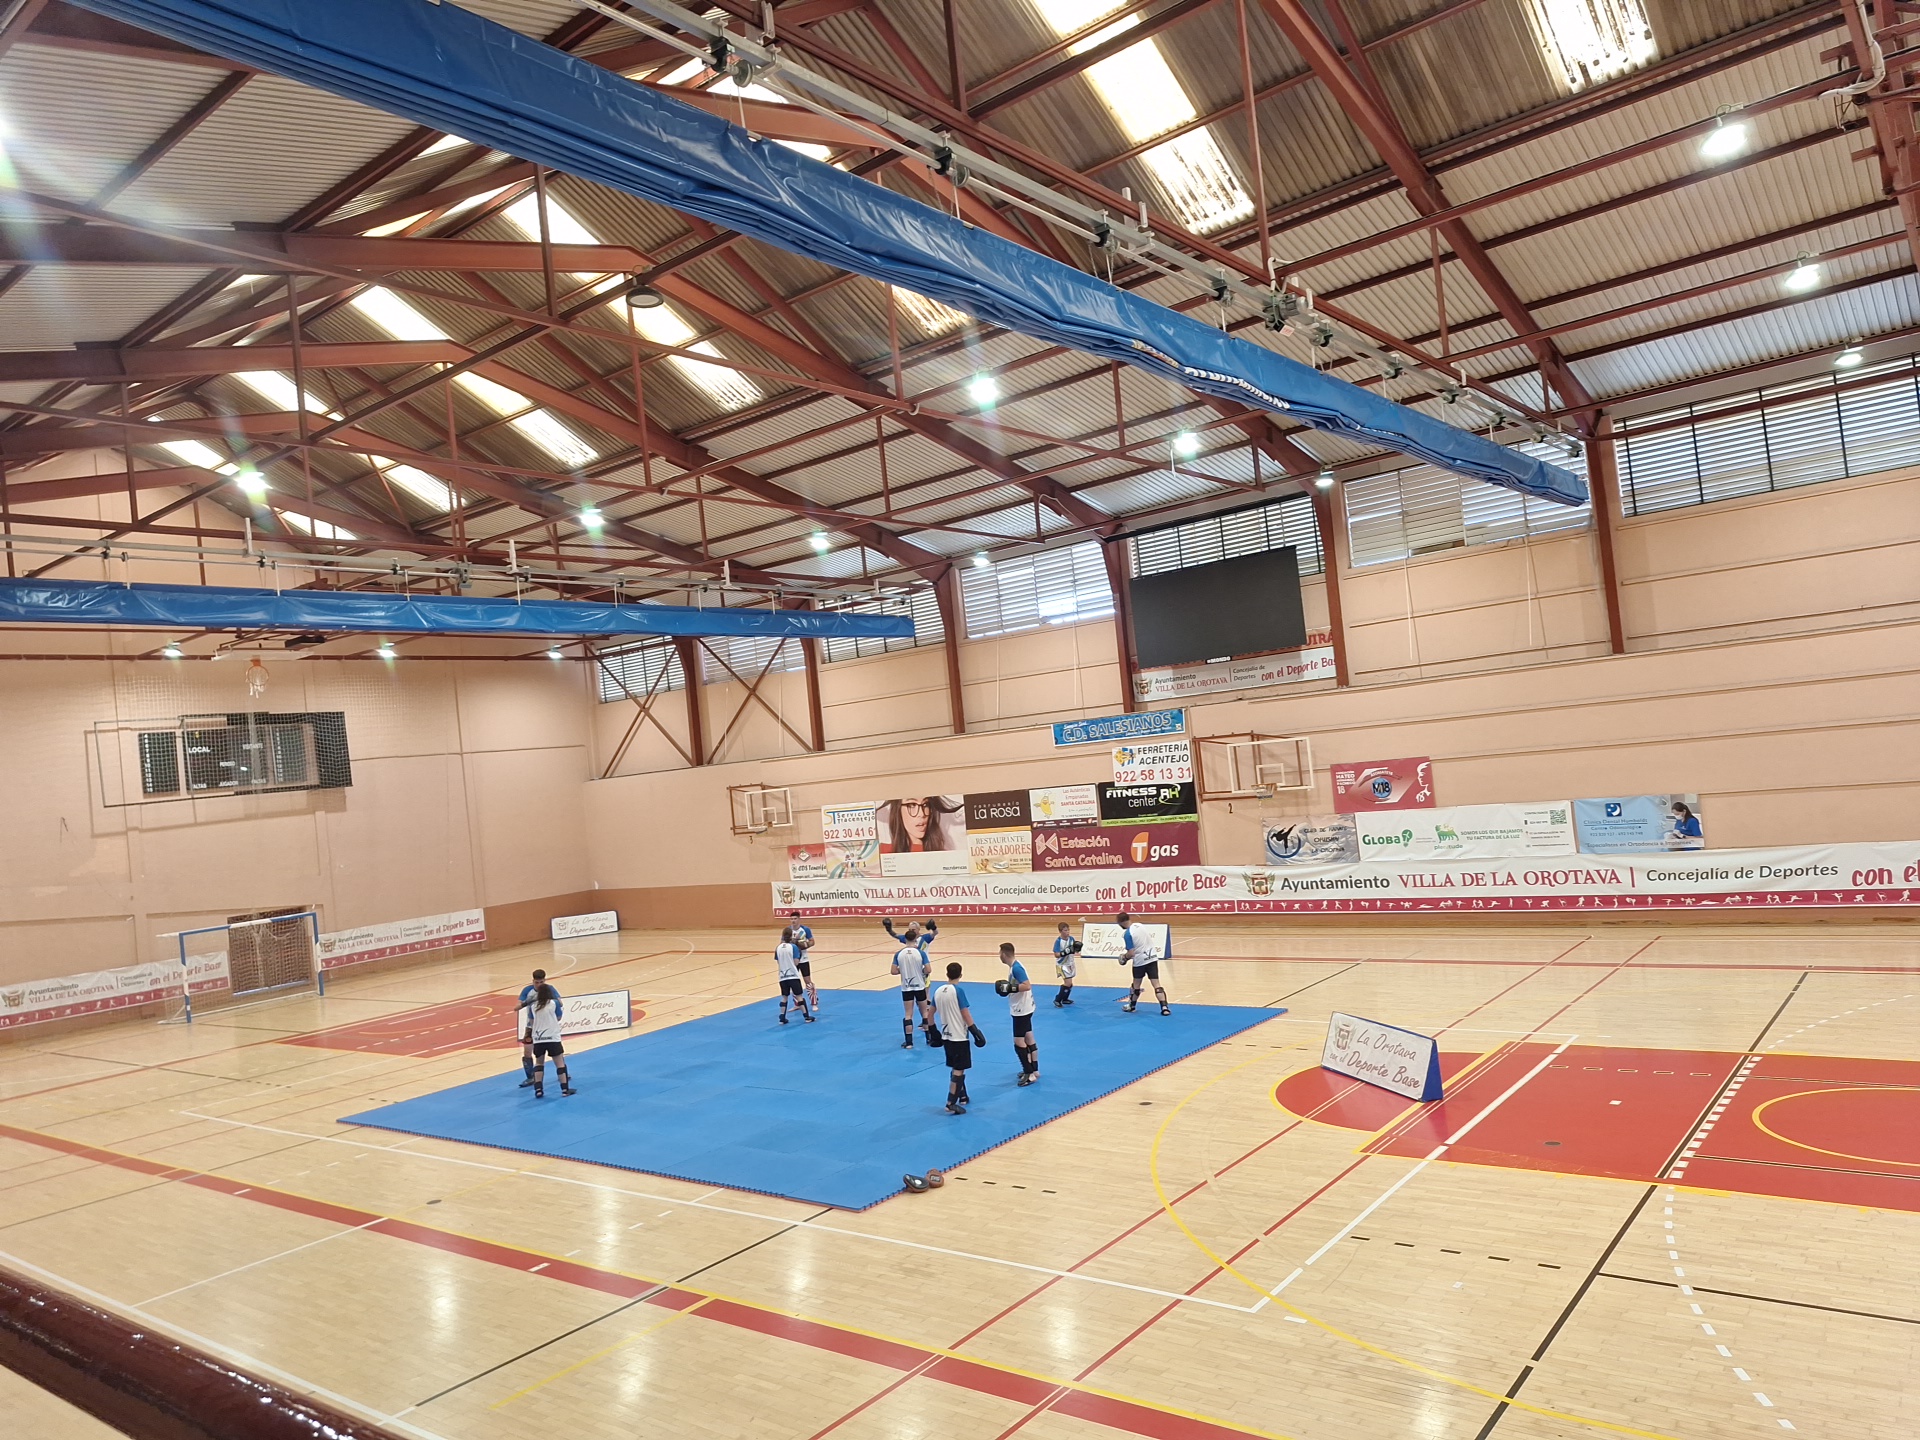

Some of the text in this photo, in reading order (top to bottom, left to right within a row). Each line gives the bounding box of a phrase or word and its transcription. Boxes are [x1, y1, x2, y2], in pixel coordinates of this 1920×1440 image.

[1234, 674, 1256, 682] Deportes
[1261, 660, 1318, 682] con el Deporte
[1155, 674, 1196, 685] Ayuntamiento
[1155, 676, 1228, 692] VILLA DE LA OROTAVA
[1063, 728, 1087, 742] C.D.
[1090, 713, 1172, 738] SALESIANOS
[1138, 743, 1188, 754] FERRETERÍA
[1138, 754, 1190, 766] ACENTEJO
[1114, 766, 1192, 783] 922 58 13 31
[1106, 787, 1157, 799] FITNESS
[1160, 788, 1179, 799] RH
[1337, 786, 1346, 794] 18
[1128, 796, 1157, 808] center
[837, 816, 875, 824] Tracentejo
[824, 827, 864, 839] 922 30 41
[976, 835, 1025, 844] RESTAURANTE
[1060, 835, 1110, 849] Estación
[970, 843, 1031, 856] LOS ASADORES
[1045, 855, 1076, 868] Santa
[1078, 852, 1123, 867] Catalina
[1280, 868, 1622, 893] Ayuntamiento VILLA DE LA OROTAVA
[1646, 864, 1838, 884] Concejalía de Deportes
[1852, 867, 1893, 886] con
[799, 884, 981, 902] Ayuntamiento VILLA DE LA OROTAVA
[993, 884, 1089, 896] Concejalía de Deportes
[1096, 873, 1227, 900] con el Deporte Base
[424, 917, 480, 937] con el Deporte Base
[1108, 929, 1117, 938] La
[338, 933, 374, 944] Ayuntamiento
[338, 935, 400, 950] VILLA DE LA OROTAVA
[163, 966, 201, 982] el Deorte
[28, 982, 79, 996] Ayuntamiento
[29, 984, 114, 1004] VILLA DE LA OROTAVA
[571, 1000, 614, 1012] Orotava
[560, 1012, 624, 1032] porte Base
[1357, 1029, 1416, 1061] La Orotava
[1330, 1050, 1421, 1088] con el Deporte Base
